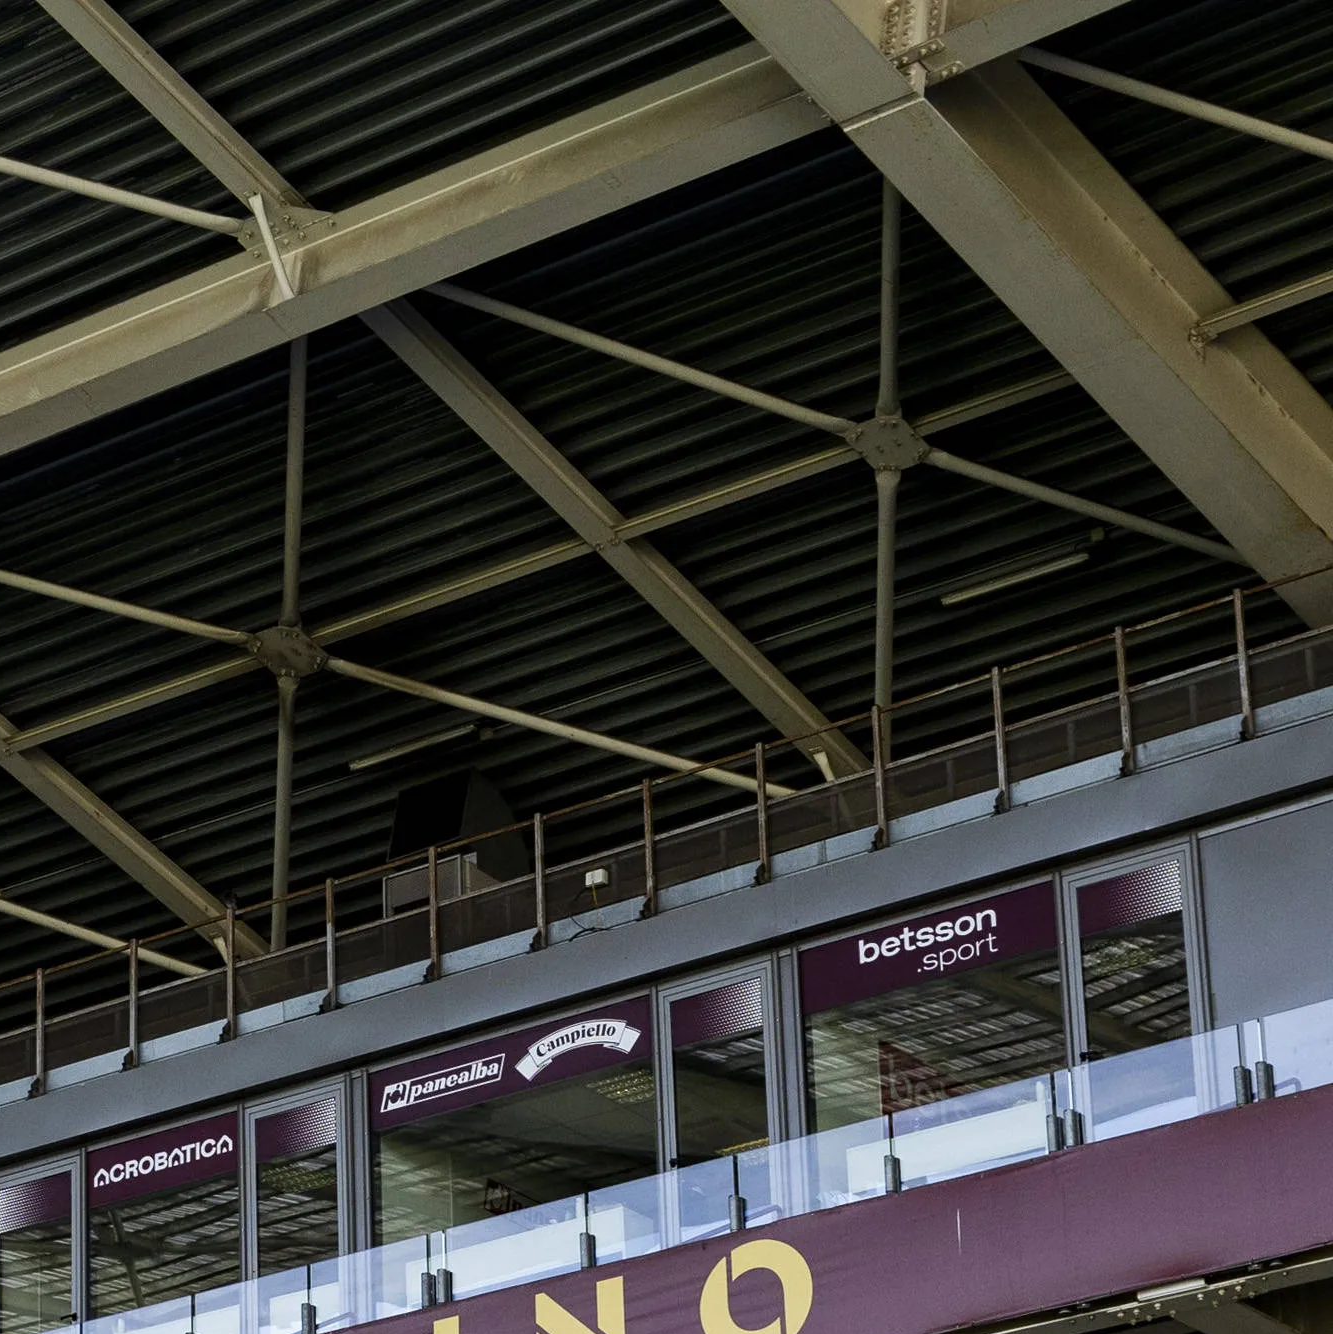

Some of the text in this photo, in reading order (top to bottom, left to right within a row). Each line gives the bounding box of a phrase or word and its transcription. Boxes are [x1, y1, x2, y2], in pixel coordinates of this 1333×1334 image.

[858, 909, 997, 965] betsson
[917, 932, 998, 974] .sport
[535, 1023, 617, 1058] Campiello
[410, 1060, 500, 1101] panealba
[93, 1133, 233, 1188] ACROBATICA
